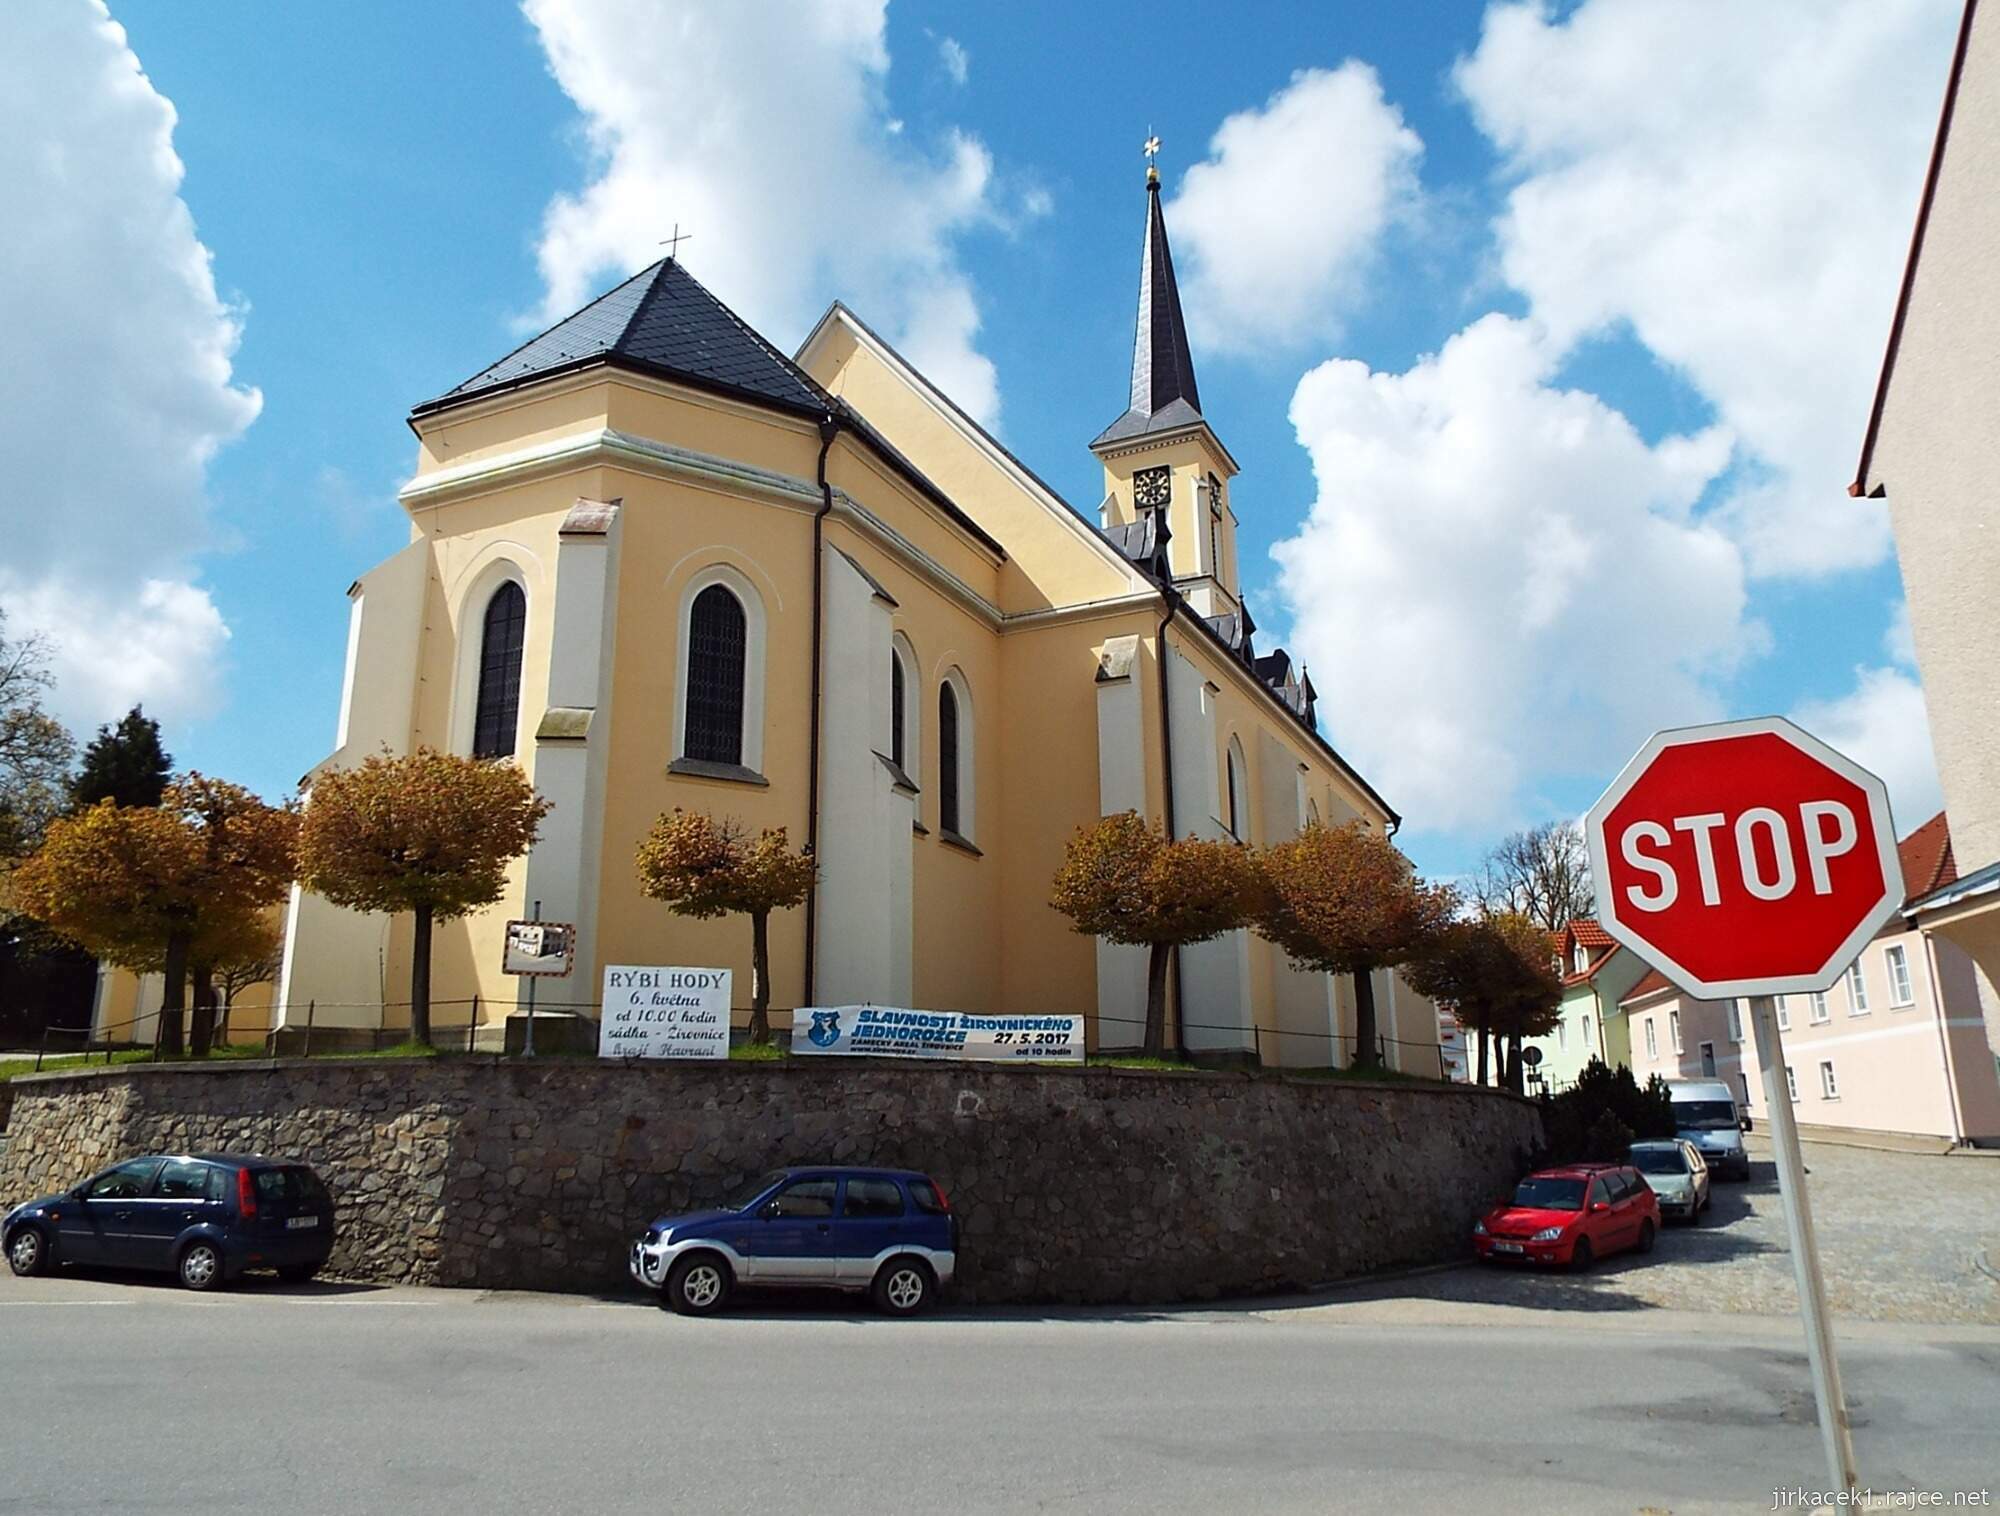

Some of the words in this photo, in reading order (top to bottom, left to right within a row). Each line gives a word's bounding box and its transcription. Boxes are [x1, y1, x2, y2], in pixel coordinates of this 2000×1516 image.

[1620, 800, 1858, 913] STOP
[629, 991, 644, 1005] 6.
[651, 991, 701, 1006] května
[615, 1009, 631, 1021] od
[637, 1009, 677, 1022] 10.00
[681, 1010, 717, 1023] hodin
[858, 1010, 956, 1029] SLAVNOSTI
[960, 1016, 1073, 1031] ŽIROVNICKÉHO
[608, 1026, 649, 1039] sádka
[667, 1024, 725, 1040] Žirovnice
[851, 1025, 967, 1043] JEDNOROŽCE
